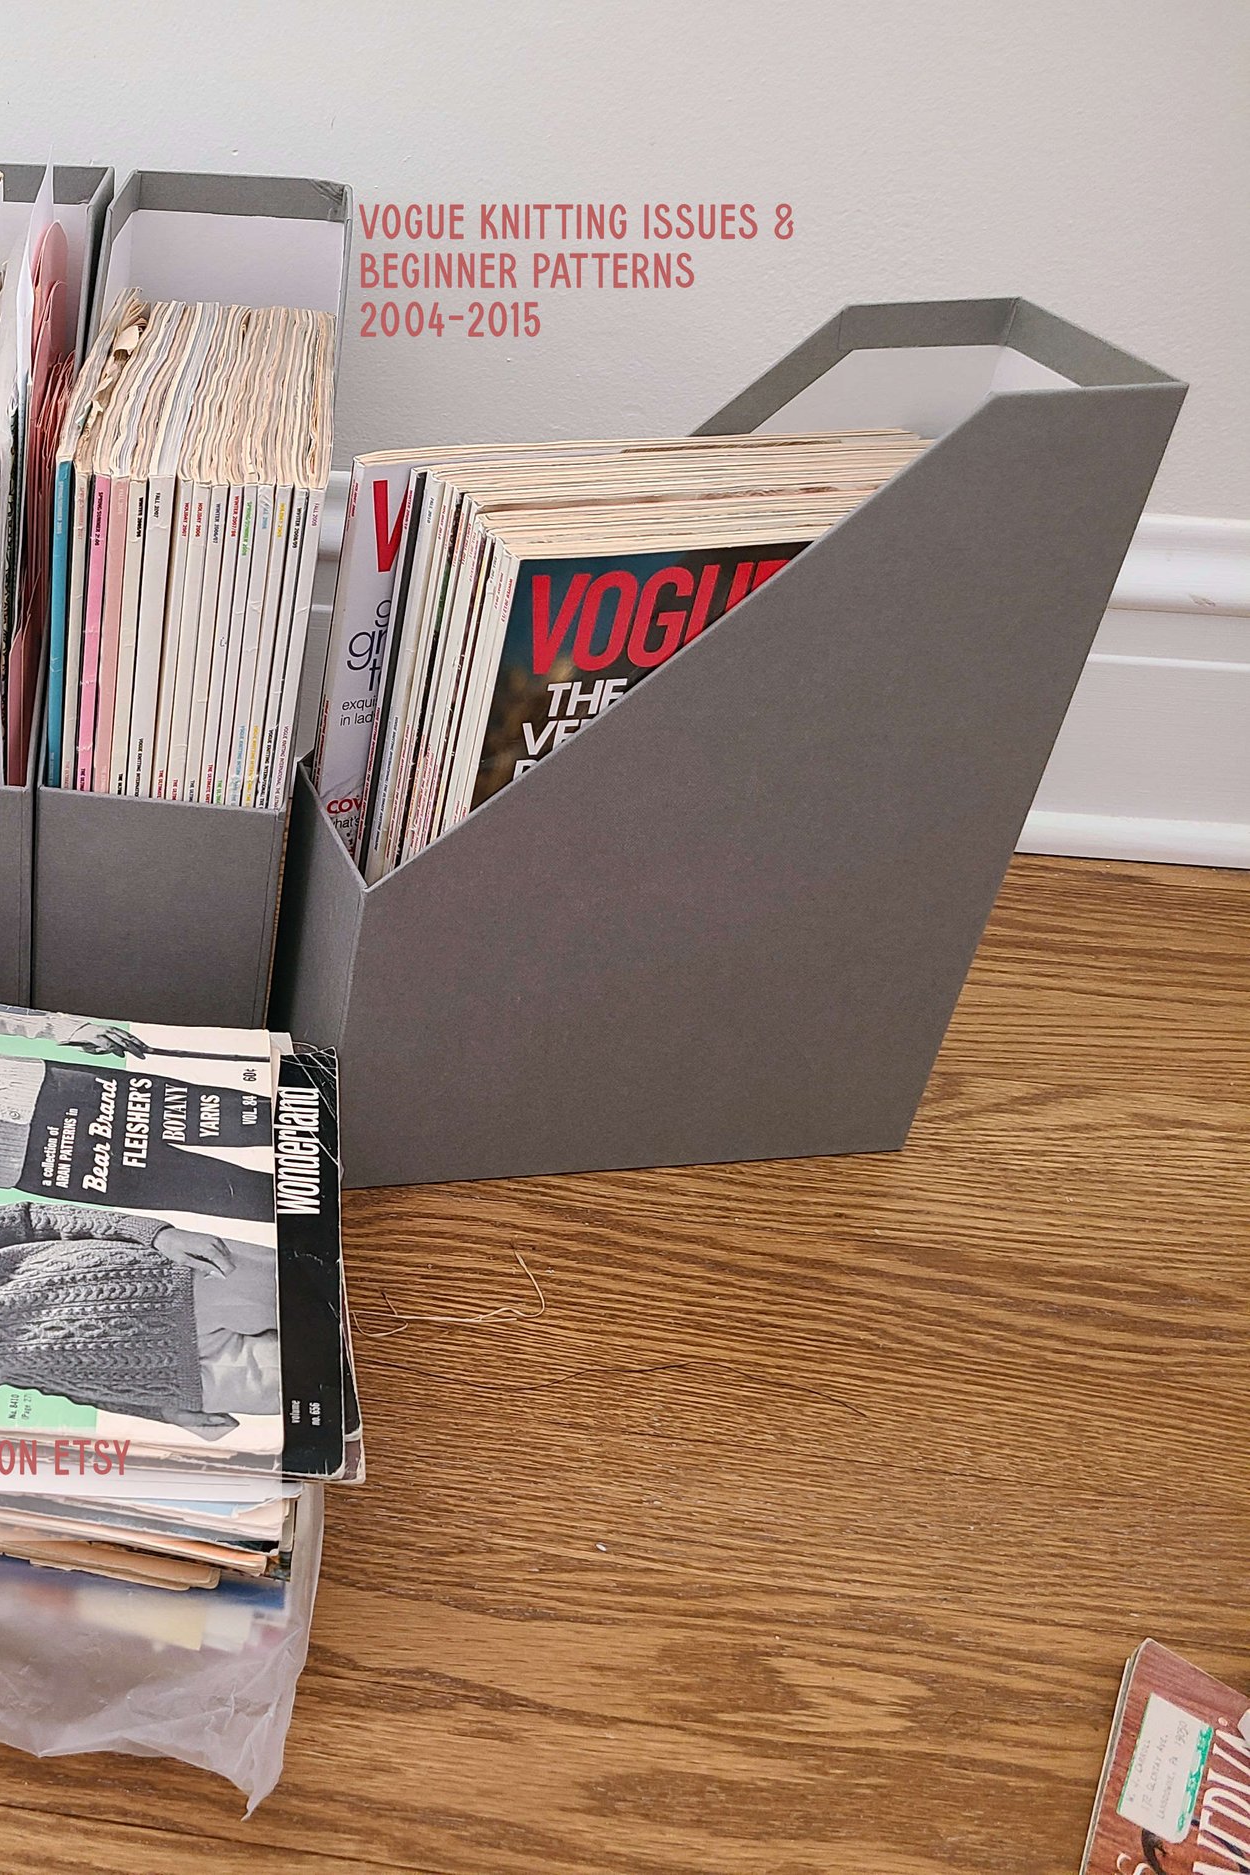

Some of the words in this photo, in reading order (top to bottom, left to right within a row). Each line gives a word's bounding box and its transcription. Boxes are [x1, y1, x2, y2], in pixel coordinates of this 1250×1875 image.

[182, 502, 190, 524] HOLIDAY
[195, 502, 204, 524] HOLIDAY
[213, 503, 221, 523] WINTER
[232, 495, 240, 516] WINTER
[312, 502, 320, 514] FALL
[341, 694, 377, 712] exqui
[546, 678, 629, 718] THE
[339, 714, 352, 726] in
[353, 712, 376, 726] lad
[88, 1077, 118, 1139] Brand
[242, 1094, 259, 1107] 84
[68, 1107, 79, 1117] in
[161, 1083, 190, 1145] BOTANY
[199, 1094, 221, 1138] YARNS
[242, 1107, 259, 1126] VOL.
[50, 1125, 61, 1138] of
[122, 1077, 153, 1169] FLEISHER'S
[58, 1120, 78, 1164] PATTERNS
[42, 1138, 59, 1179] collection
[82, 1141, 112, 1194] Bear
[41, 1178, 52, 1187] a
[55, 1165, 69, 1189] ARAN
[290, 1399, 301, 1425] volume
[310, 1401, 322, 1415] 656
[311, 1415, 322, 1426] no.
